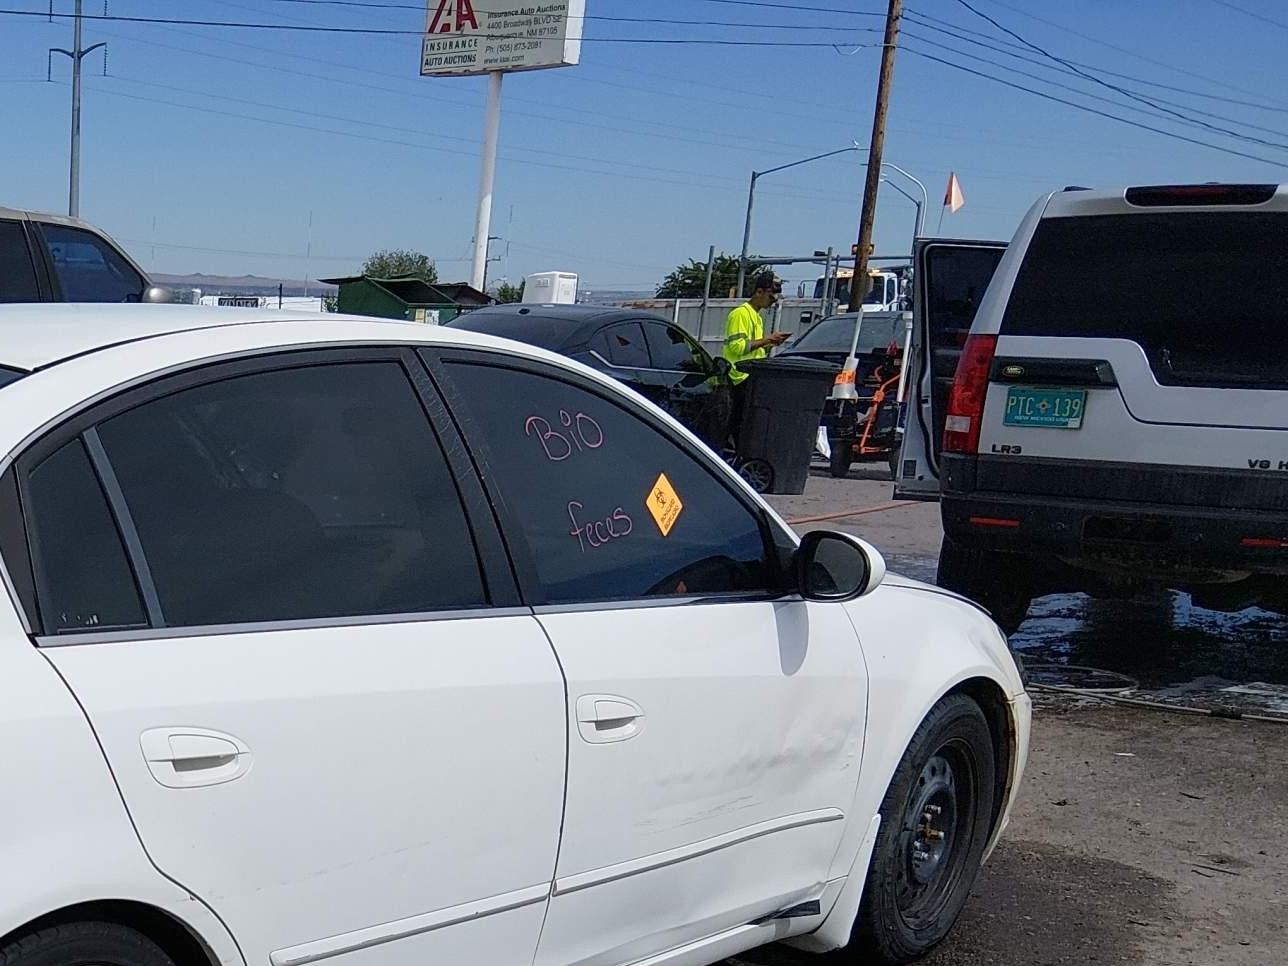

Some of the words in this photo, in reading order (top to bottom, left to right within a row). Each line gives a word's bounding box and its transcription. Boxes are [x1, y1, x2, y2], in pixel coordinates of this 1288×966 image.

[536, 4, 566, 13] Auctions
[425, 38, 478, 52] INSURANCE
[424, 56, 443, 66] AUTO
[443, 53, 477, 65] AUCTIONS
[1007, 396, 1035, 416] PTC
[1052, 398, 1081, 418] 139
[991, 443, 1022, 454] LR3
[1247, 458, 1271, 469] V8
